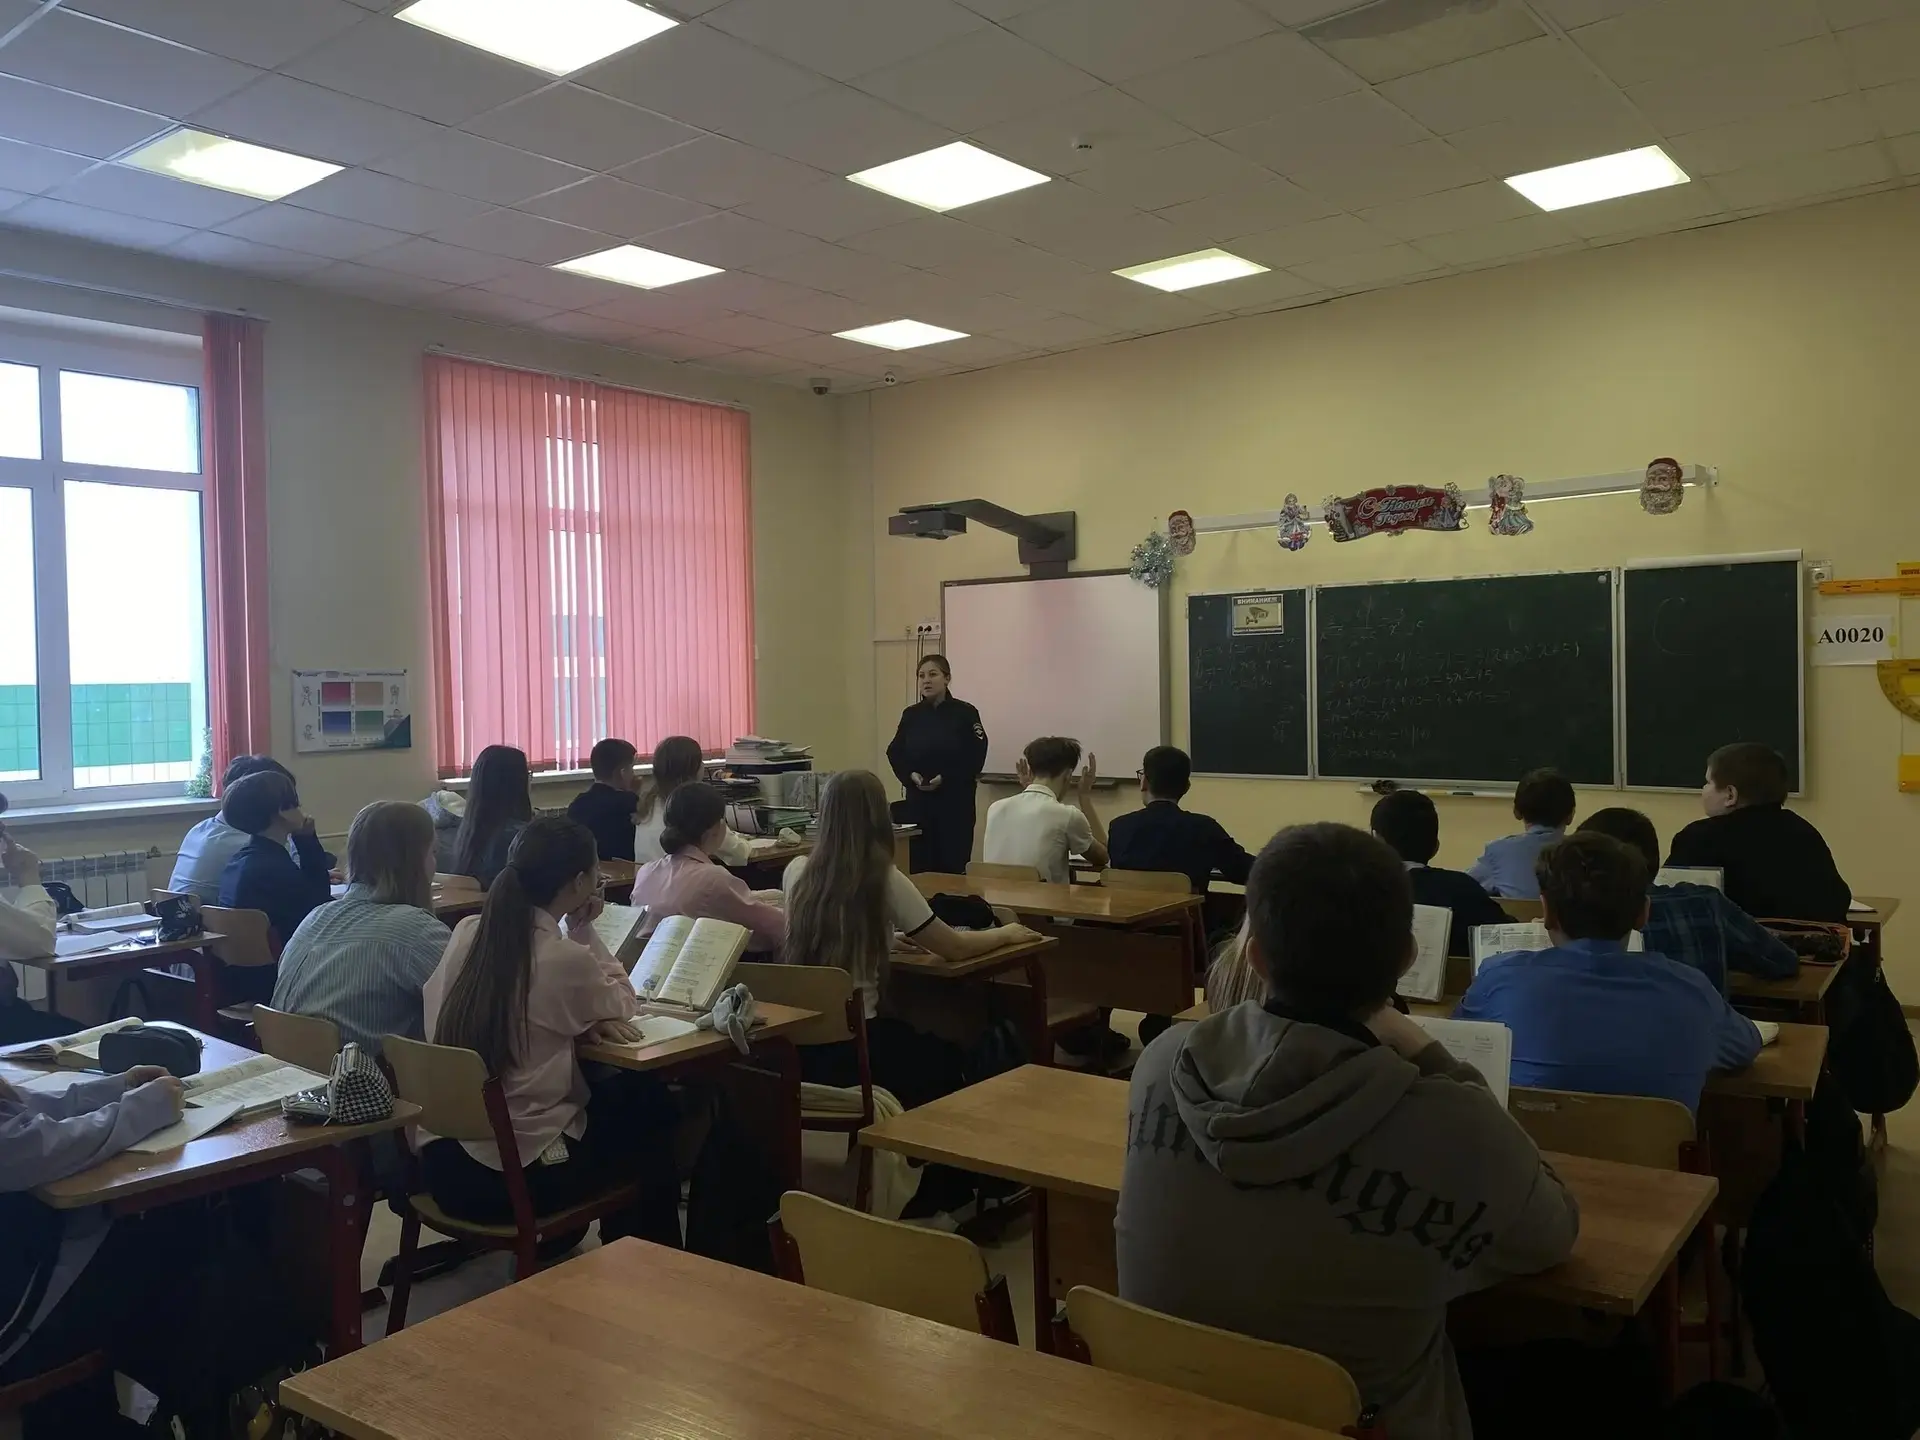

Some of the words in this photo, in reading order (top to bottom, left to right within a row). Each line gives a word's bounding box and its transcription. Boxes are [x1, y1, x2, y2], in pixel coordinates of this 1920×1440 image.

[1358, 497, 1378, 519] С
[1817, 627, 1884, 644] A0020
[1292, 1151, 1495, 1272] ngels
